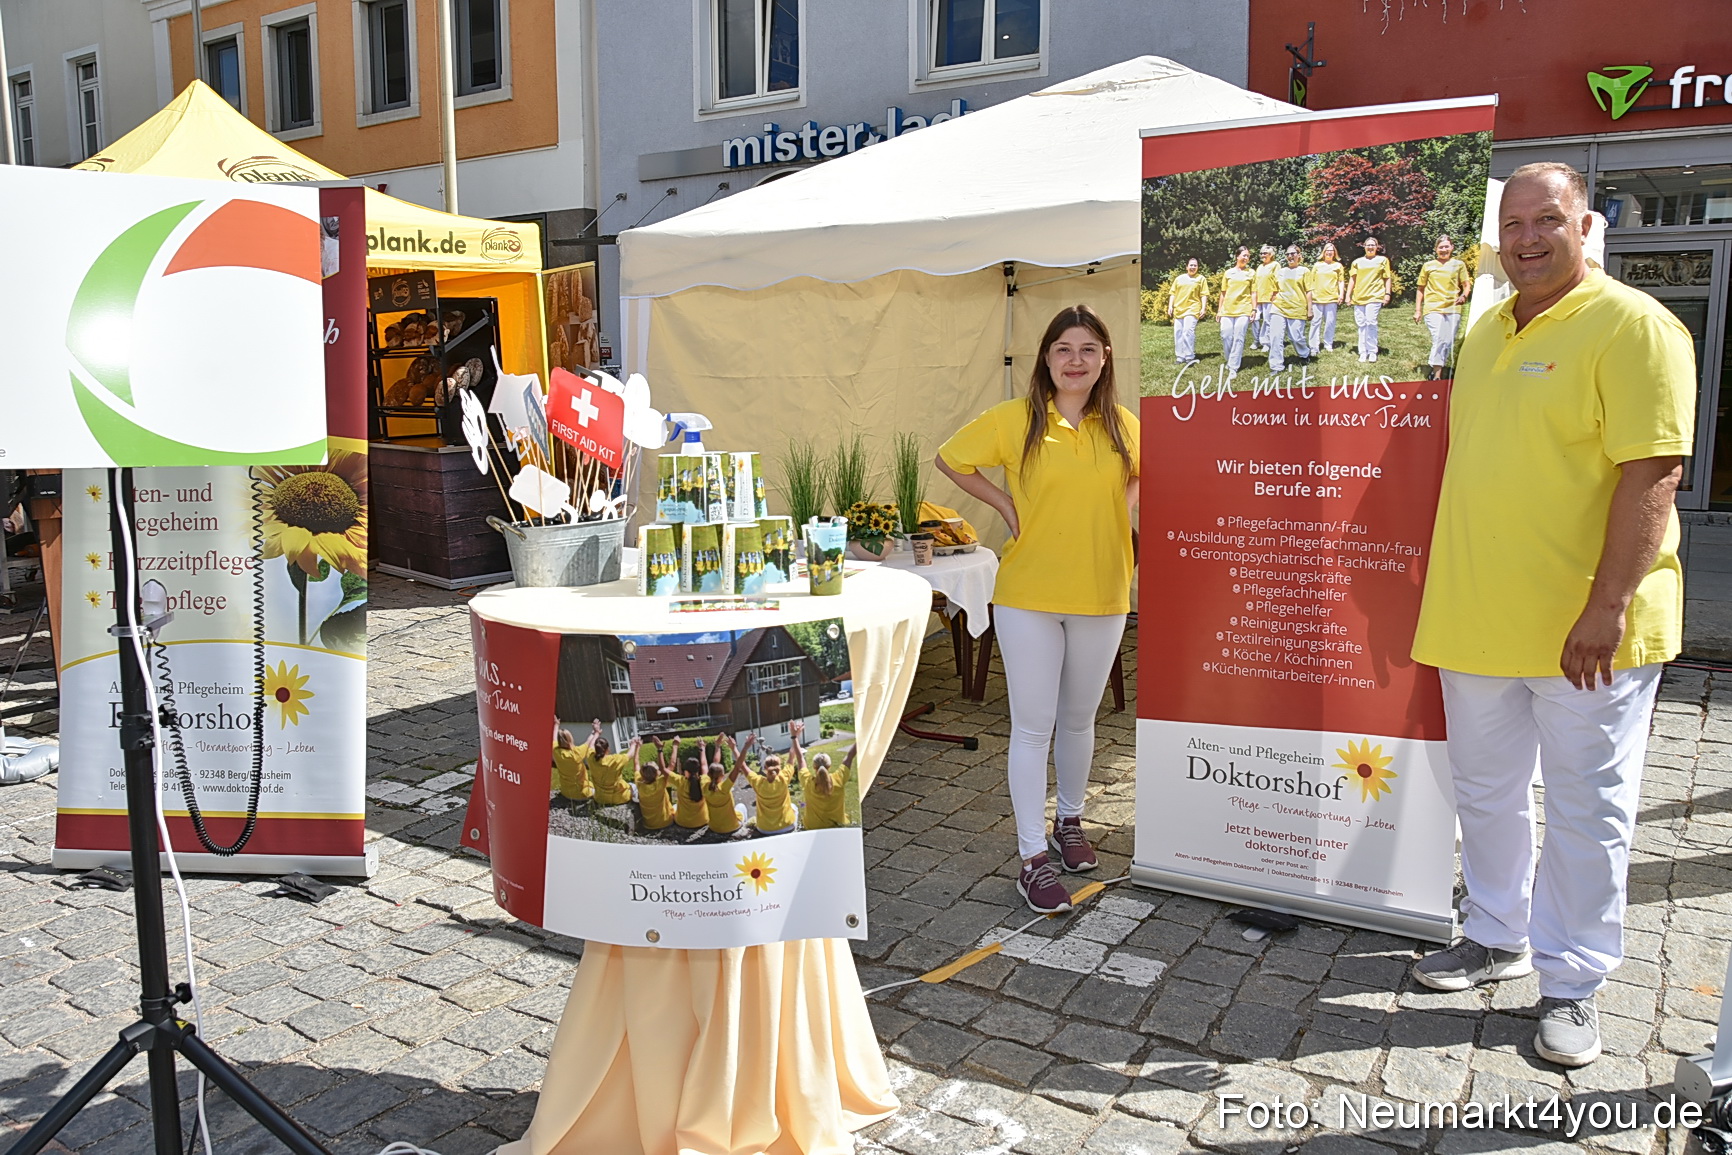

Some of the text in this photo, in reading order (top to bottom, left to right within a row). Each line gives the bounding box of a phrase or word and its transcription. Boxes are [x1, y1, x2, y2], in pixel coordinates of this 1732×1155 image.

[723, 122, 869, 168] mister
[484, 239, 510, 254] plank
[1171, 359, 1439, 421] Geh mit uns...
[1232, 404, 1432, 429] komm in unser Team
[551, 419, 616, 462] FIRST AID KIT
[1216, 459, 1383, 480] Wir bieten folgende
[176, 482, 214, 503] und
[1254, 481, 1343, 499] Berufe an:
[1227, 516, 1368, 534] Pflegefachmann/-frau
[1177, 530, 1422, 557] Ausbildung zum Pflegefachmann/-frau
[1190, 547, 1406, 573] Gerontopsychiatrische Fachkräfte
[1239, 567, 1352, 585] Betreuungskräfte
[1243, 583, 1347, 602] Pflegefachhelfer
[1255, 601, 1333, 618] Pflegehelfer
[1240, 616, 1348, 637] Reinigungskräfte
[1225, 631, 1363, 655] Textilreinigungskräfte
[1233, 648, 1272, 663] Köche
[1284, 652, 1353, 670] Köchinnen
[1211, 662, 1376, 690] Küchenmitarbeiter/-innen
[178, 682, 245, 699] Pflegeheim
[492, 689, 521, 715] Team
[285, 741, 316, 754] Leben
[494, 730, 504, 743] der
[505, 733, 529, 752] Pflege
[1187, 737, 1325, 766] Alten- und Pflegeheim
[200, 770, 226, 779] 92348
[498, 763, 521, 786] frau
[1186, 754, 1349, 801] Doktorshof
[1227, 796, 1260, 813] Pflege
[1272, 802, 1352, 827] Verantwortung
[1364, 815, 1396, 831] Leben
[1225, 822, 1349, 850] Jetzt bewerben unter
[1245, 839, 1327, 861] doktorshof.de
[1261, 857, 1274, 865] oder
[1286, 861, 1299, 869] Post
[629, 870, 729, 882] Alten- und Pflegeheim
[1174, 852, 1190, 860] Alten-
[1202, 857, 1233, 868] Pflegeheim
[1233, 862, 1265, 873] Doktorshof
[1271, 868, 1321, 883] Doktorshofstraße
[1335, 880, 1354, 889] 92348
[1354, 883, 1368, 892] Berg
[1373, 886, 1404, 898] Hausheim
[629, 881, 746, 903] Doktorshof
[662, 909, 686, 920] Pflege
[695, 909, 751, 919] Verantwortung
[760, 903, 781, 912] Leben
